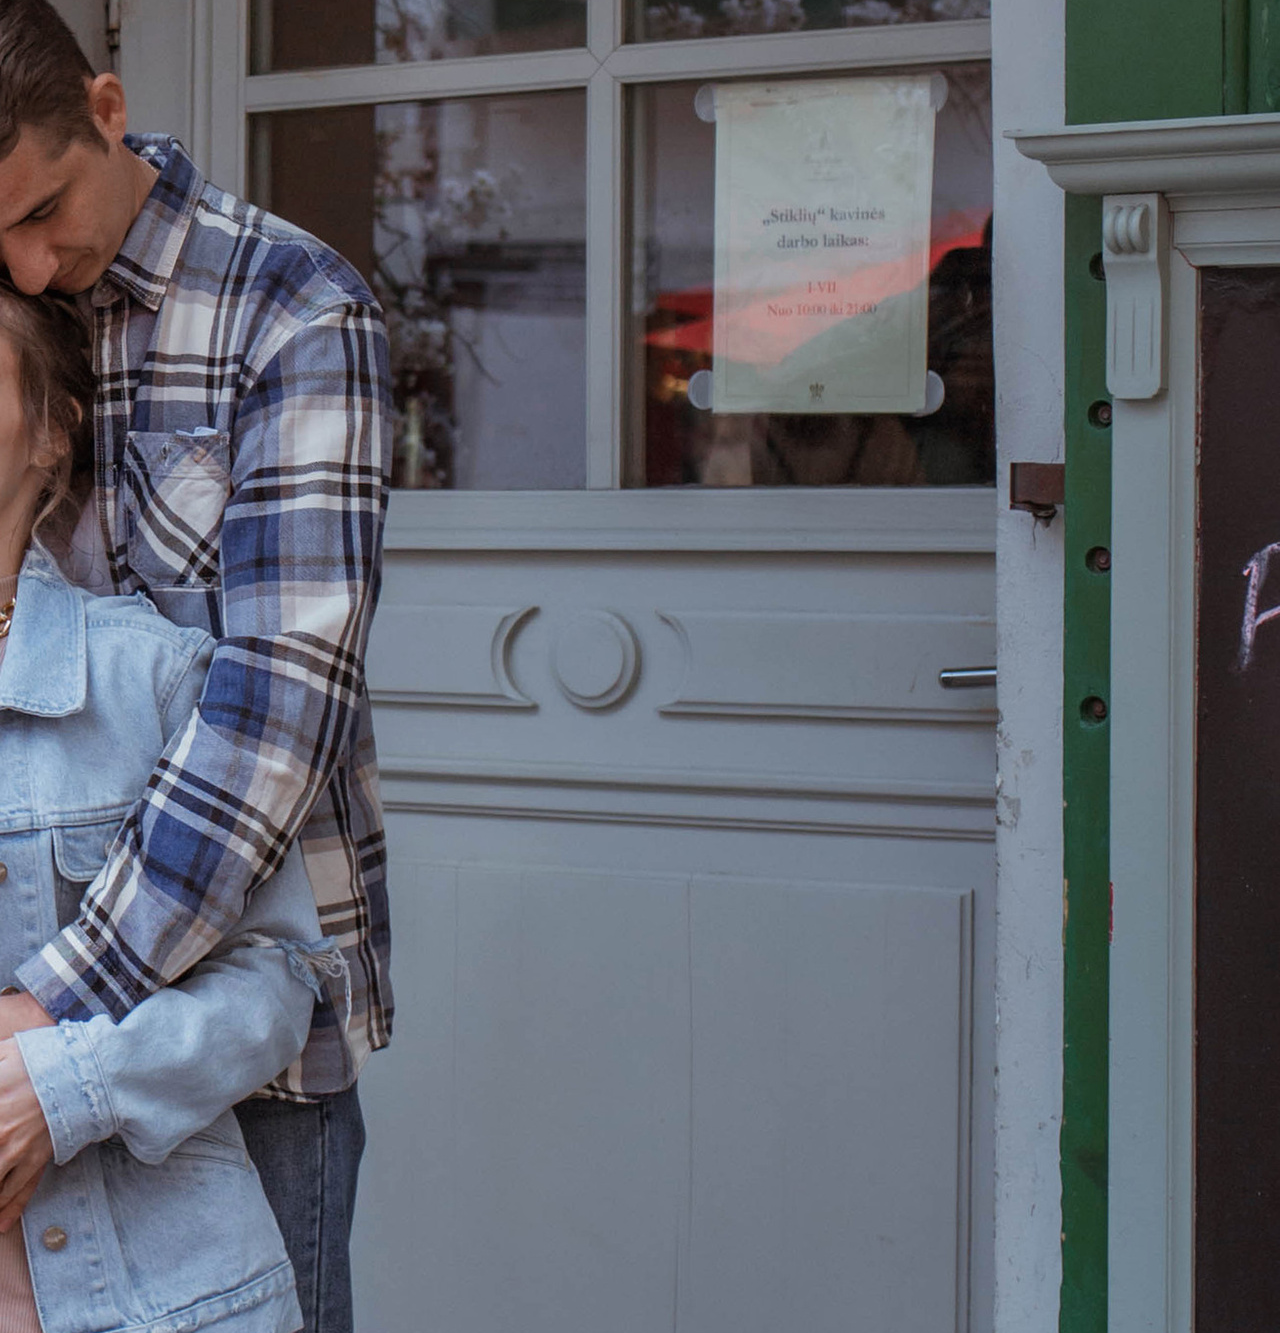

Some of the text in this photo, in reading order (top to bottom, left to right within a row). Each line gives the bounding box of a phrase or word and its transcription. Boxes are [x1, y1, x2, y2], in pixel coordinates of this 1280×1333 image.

[777, 233, 869, 248] darbo laikas:
[766, 304, 793, 316] Nuo
